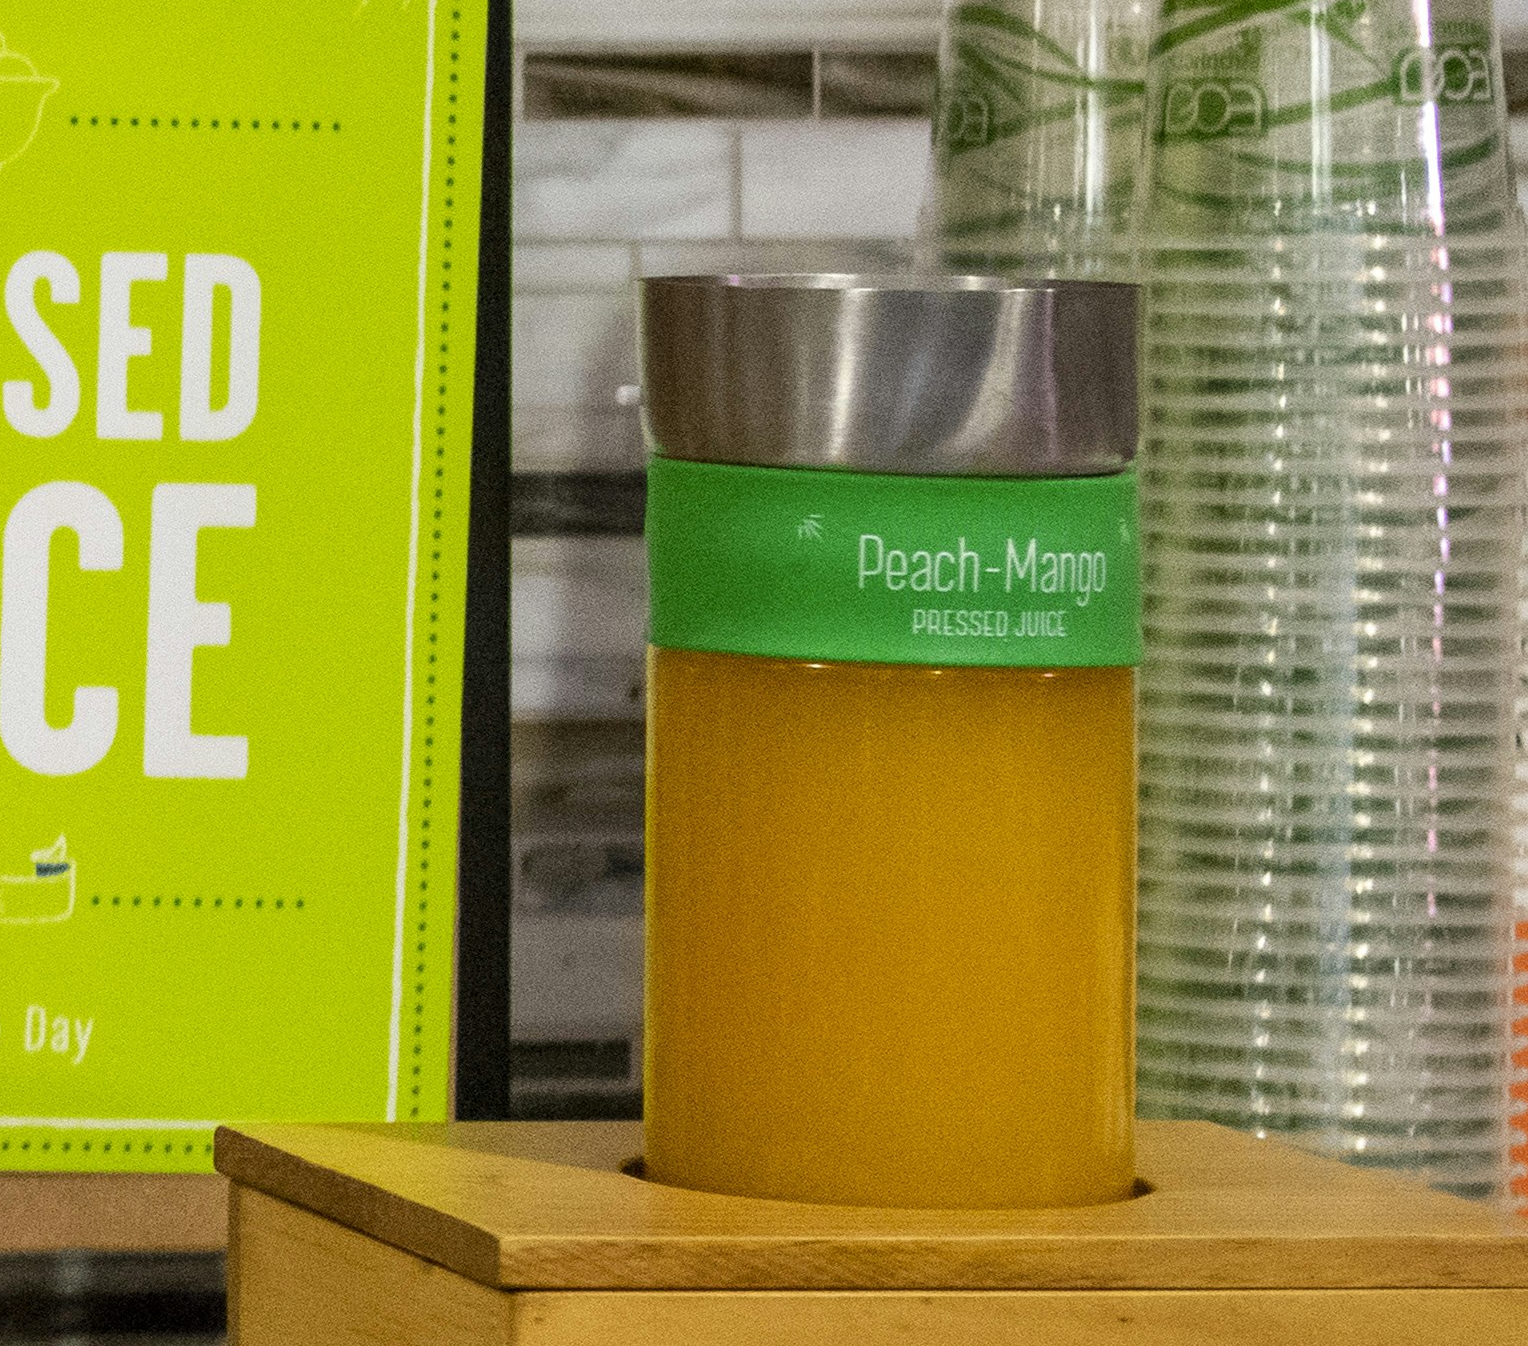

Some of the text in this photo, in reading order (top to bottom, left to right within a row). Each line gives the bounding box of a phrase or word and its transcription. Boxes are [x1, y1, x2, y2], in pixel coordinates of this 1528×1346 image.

[858, 534, 1107, 607] Peach-Mango
[913, 609, 1067, 638] PRESSED JUICE
[25, 1005, 93, 1065] Day
